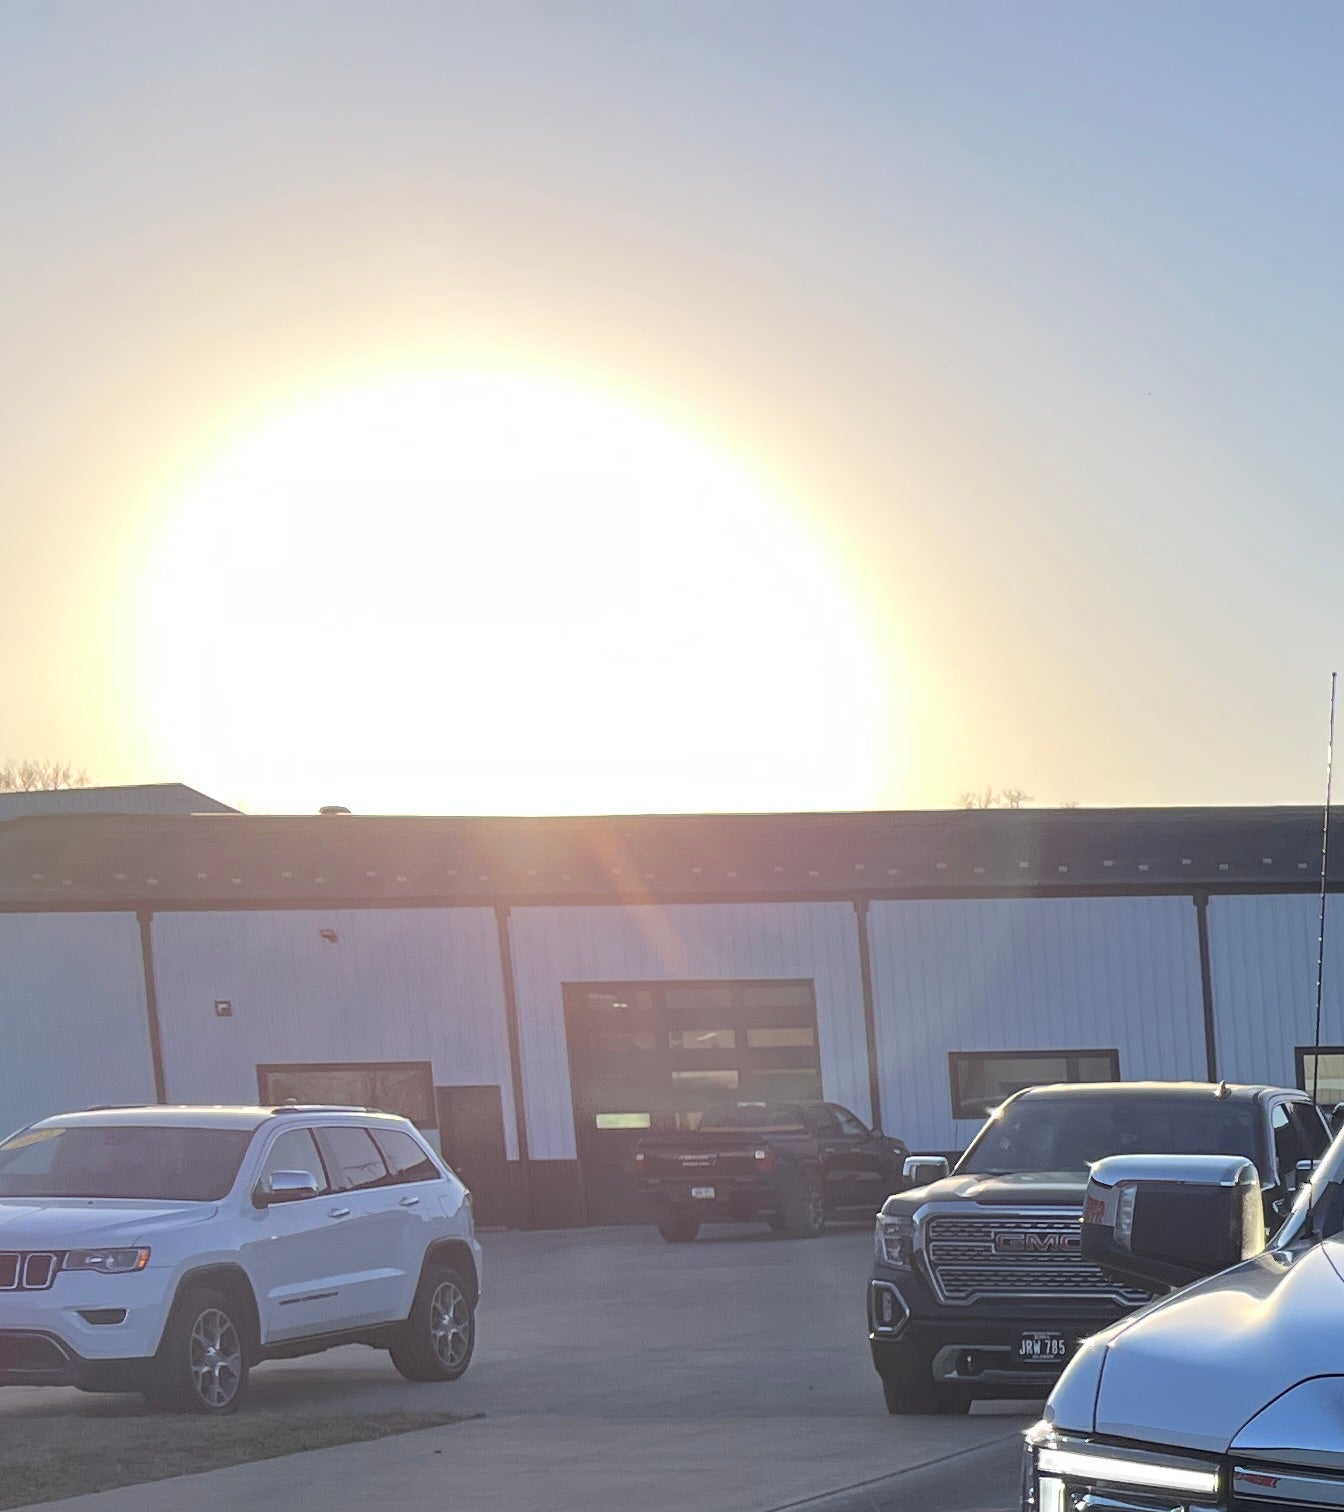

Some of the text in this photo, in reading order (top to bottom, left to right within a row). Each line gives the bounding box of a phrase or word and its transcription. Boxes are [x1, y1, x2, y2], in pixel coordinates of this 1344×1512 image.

[995, 1233, 1081, 1251] GMC
[1018, 1339, 1066, 1355] JRW 785
